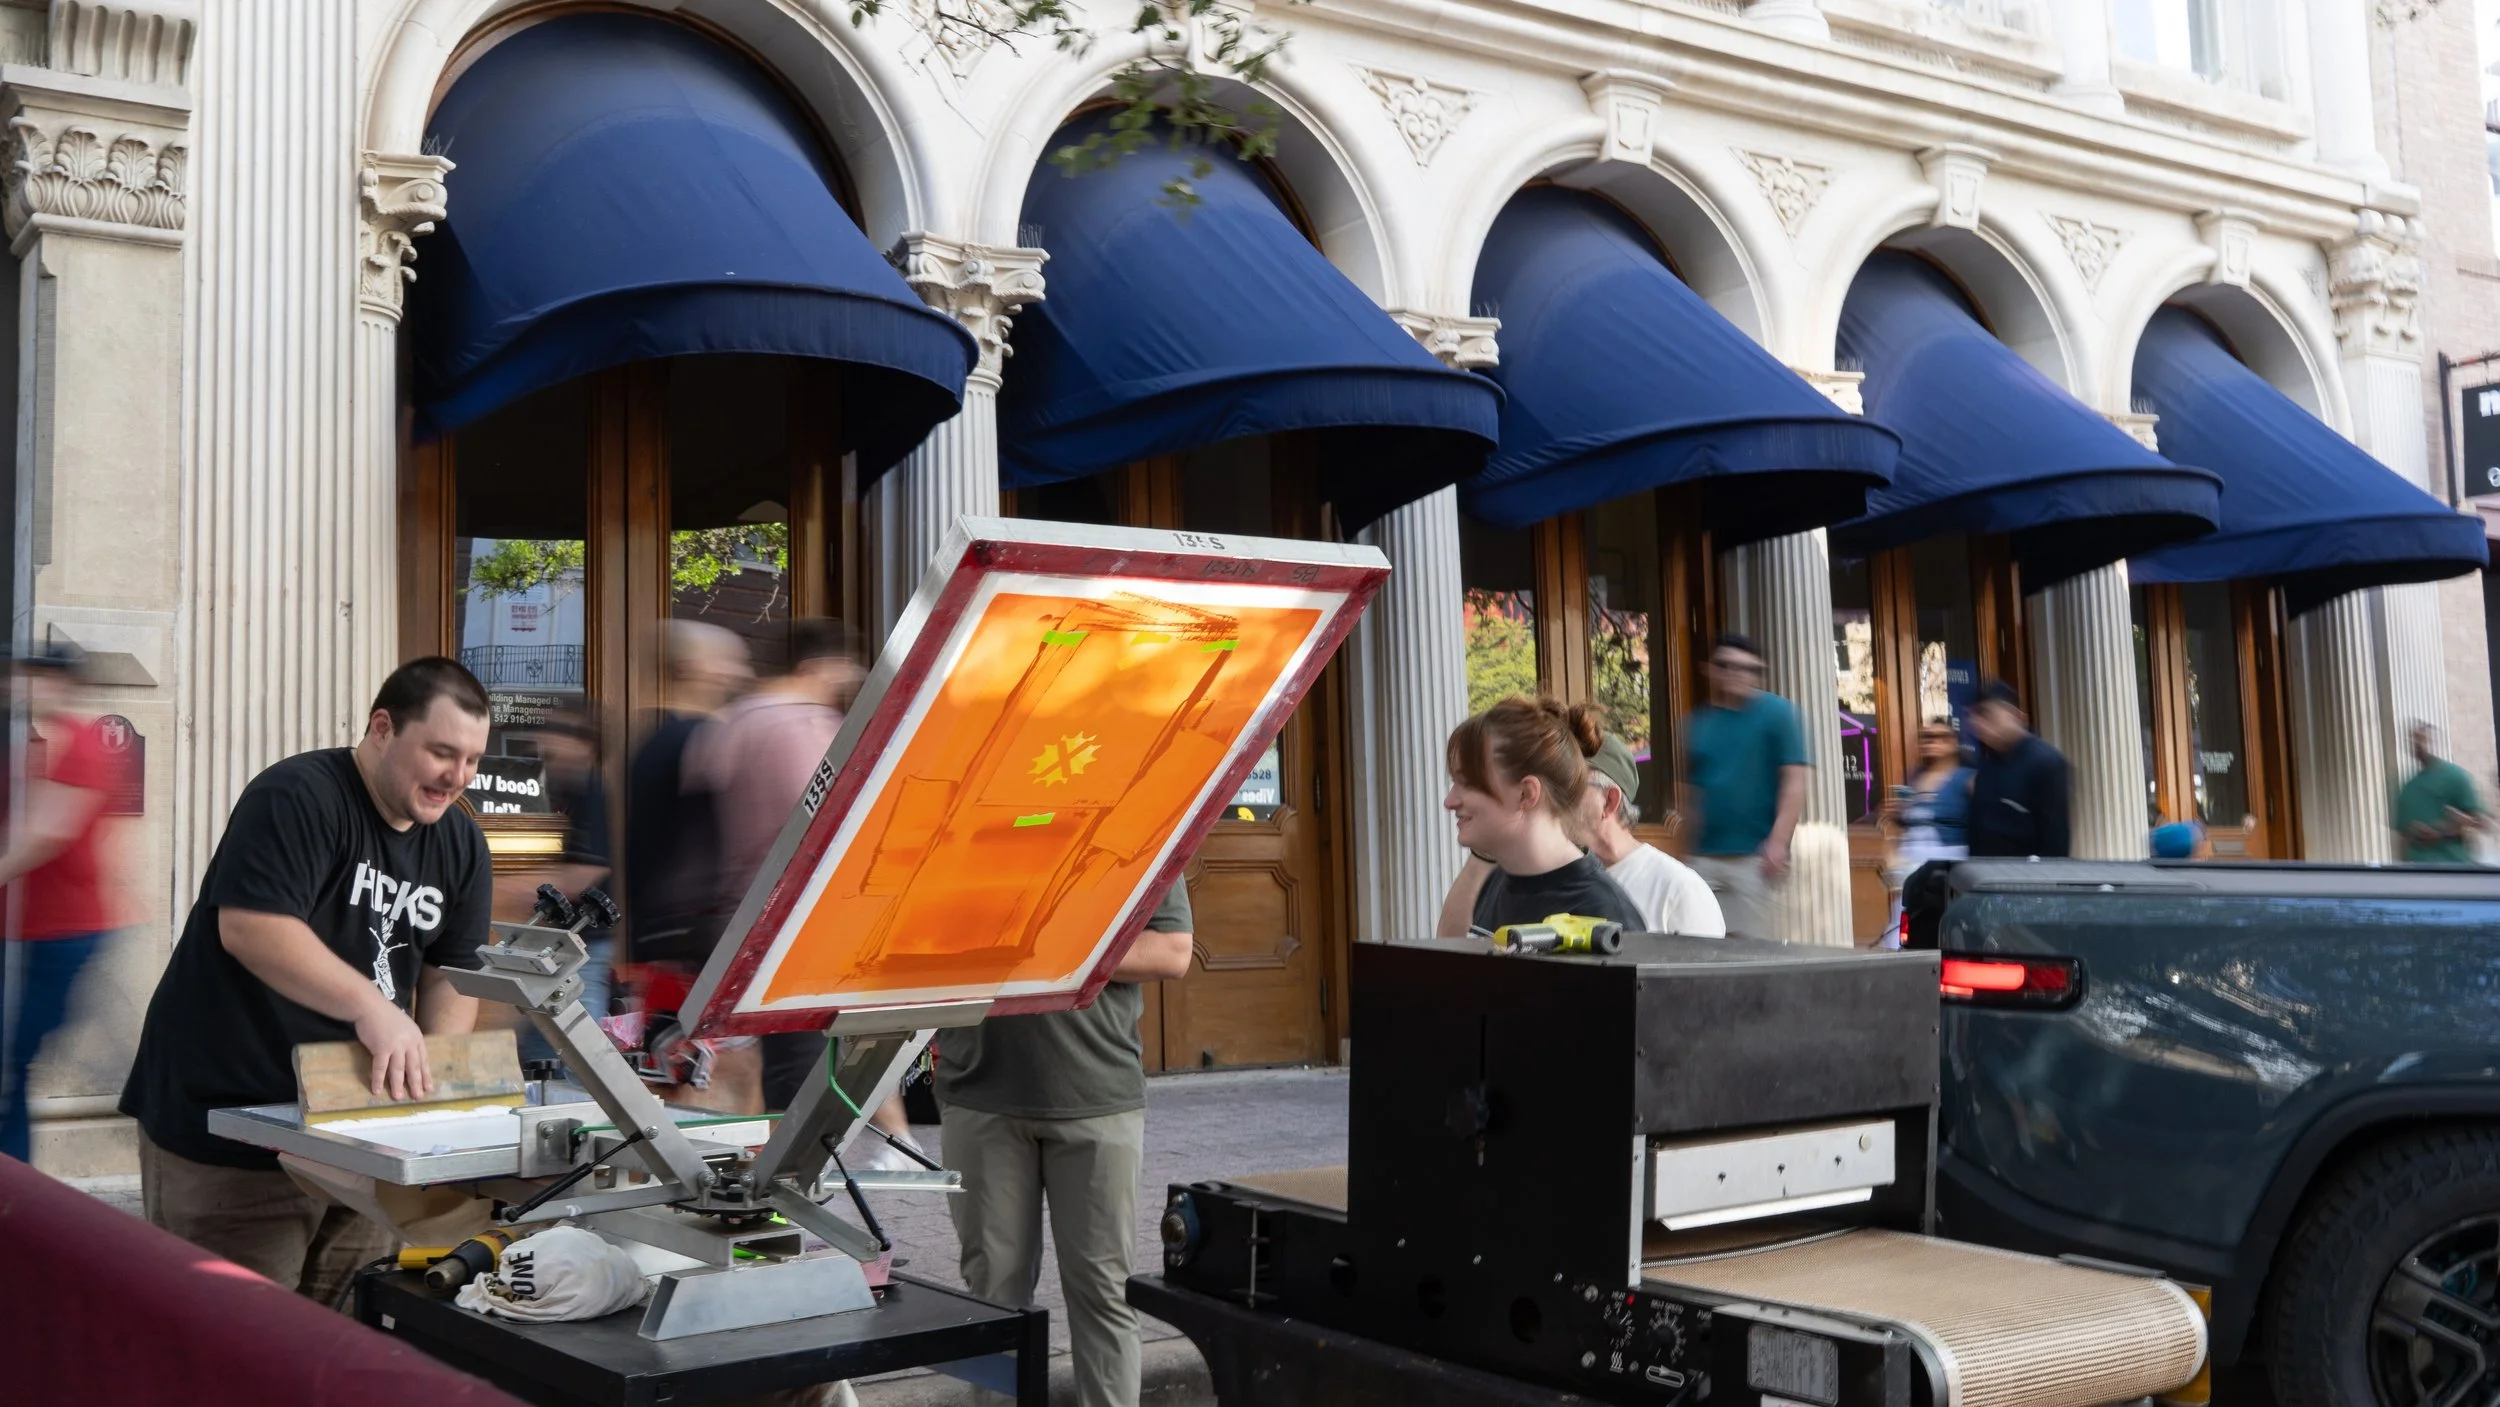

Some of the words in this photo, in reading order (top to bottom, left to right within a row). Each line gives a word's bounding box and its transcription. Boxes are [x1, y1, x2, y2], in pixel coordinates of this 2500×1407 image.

[489, 694, 514, 705] uilding
[515, 694, 551, 706] Managed
[503, 704, 554, 715] Management
[494, 714, 509, 723] 512
[510, 716, 545, 725] 916-0123
[509, 1250, 537, 1295] ONE
